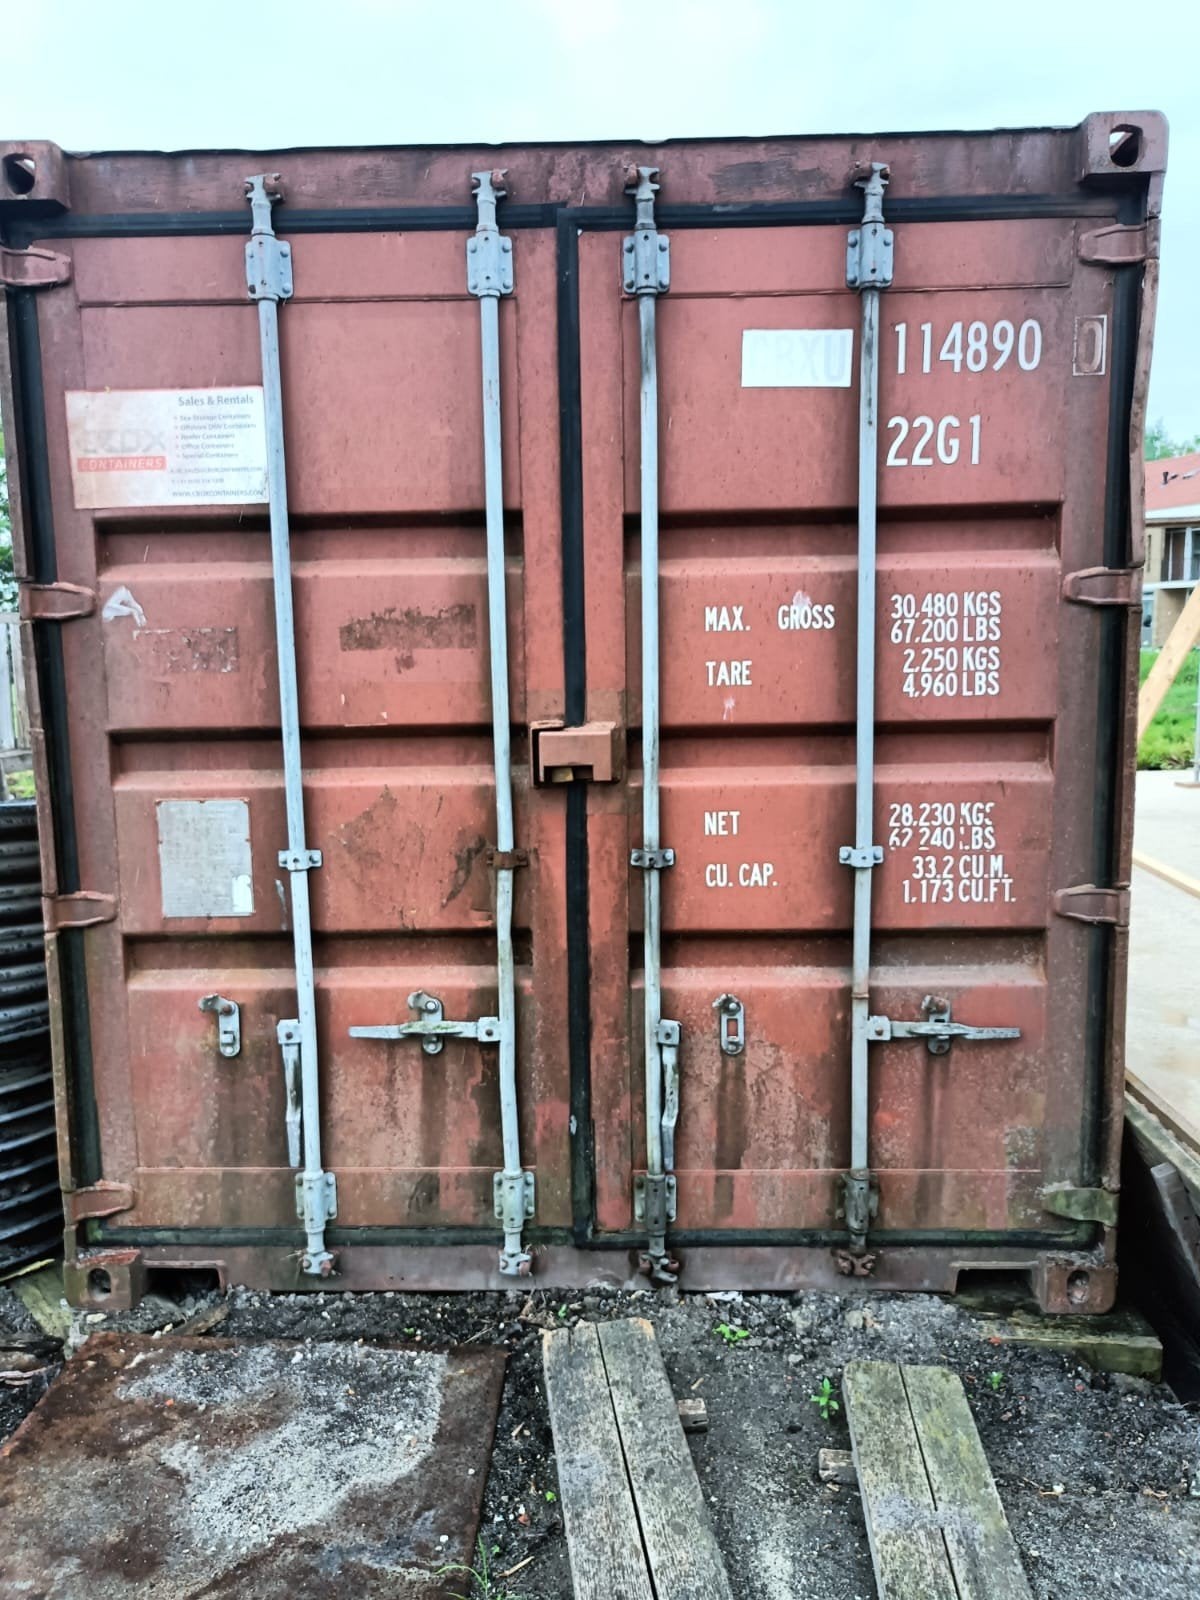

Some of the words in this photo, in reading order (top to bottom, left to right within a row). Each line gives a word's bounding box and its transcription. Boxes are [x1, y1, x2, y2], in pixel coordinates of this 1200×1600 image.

[895, 319, 1042, 373] 114890
[178, 396, 205, 406] Sales
[207, 396, 215, 406] &
[217, 394, 254, 405] Rentals
[886, 414, 981, 466] 22G1
[81, 457, 163, 471] CONTAINERS
[963, 591, 1002, 617] KGS
[705, 606, 751, 632] MAX.
[777, 604, 836, 631] GROSS
[963, 616, 1001, 642] LBS
[962, 646, 1001, 672] KGS
[705, 660, 753, 687] TARE
[962, 671, 1000, 697] LBS
[705, 810, 740, 836] NET
[959, 802, 995, 827] KGS
[705, 863, 734, 888] CU.
[738, 861, 778, 887] CAP.
[911, 855, 955, 879] 33.2
[958, 854, 1009, 879] CU.M.
[958, 878, 1017, 903] CU.FT.
